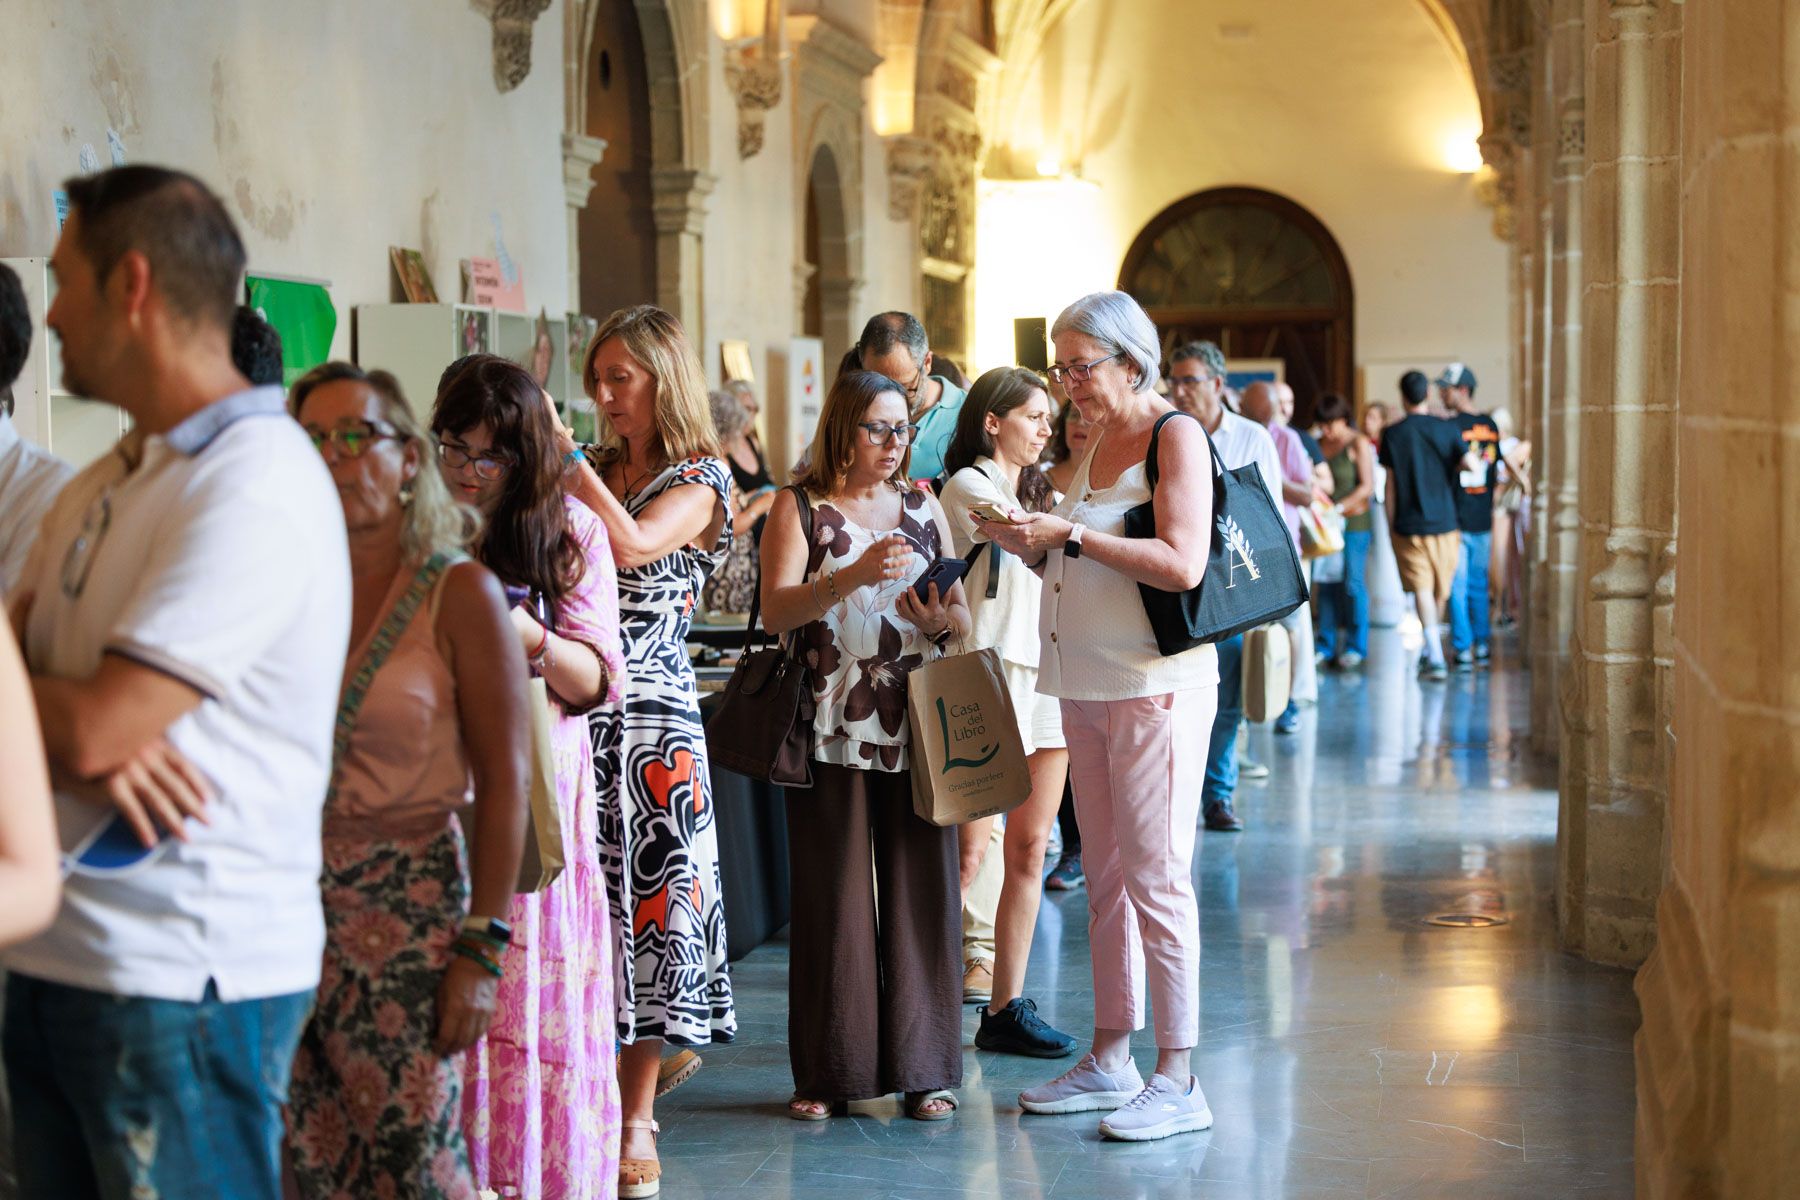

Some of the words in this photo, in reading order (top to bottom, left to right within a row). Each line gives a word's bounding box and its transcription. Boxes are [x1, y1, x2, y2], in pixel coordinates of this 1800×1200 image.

[950, 702, 980, 718] Casa
[967, 713, 984, 725] del
[954, 725, 986, 742] Libro
[948, 779, 975, 793] Gracias
